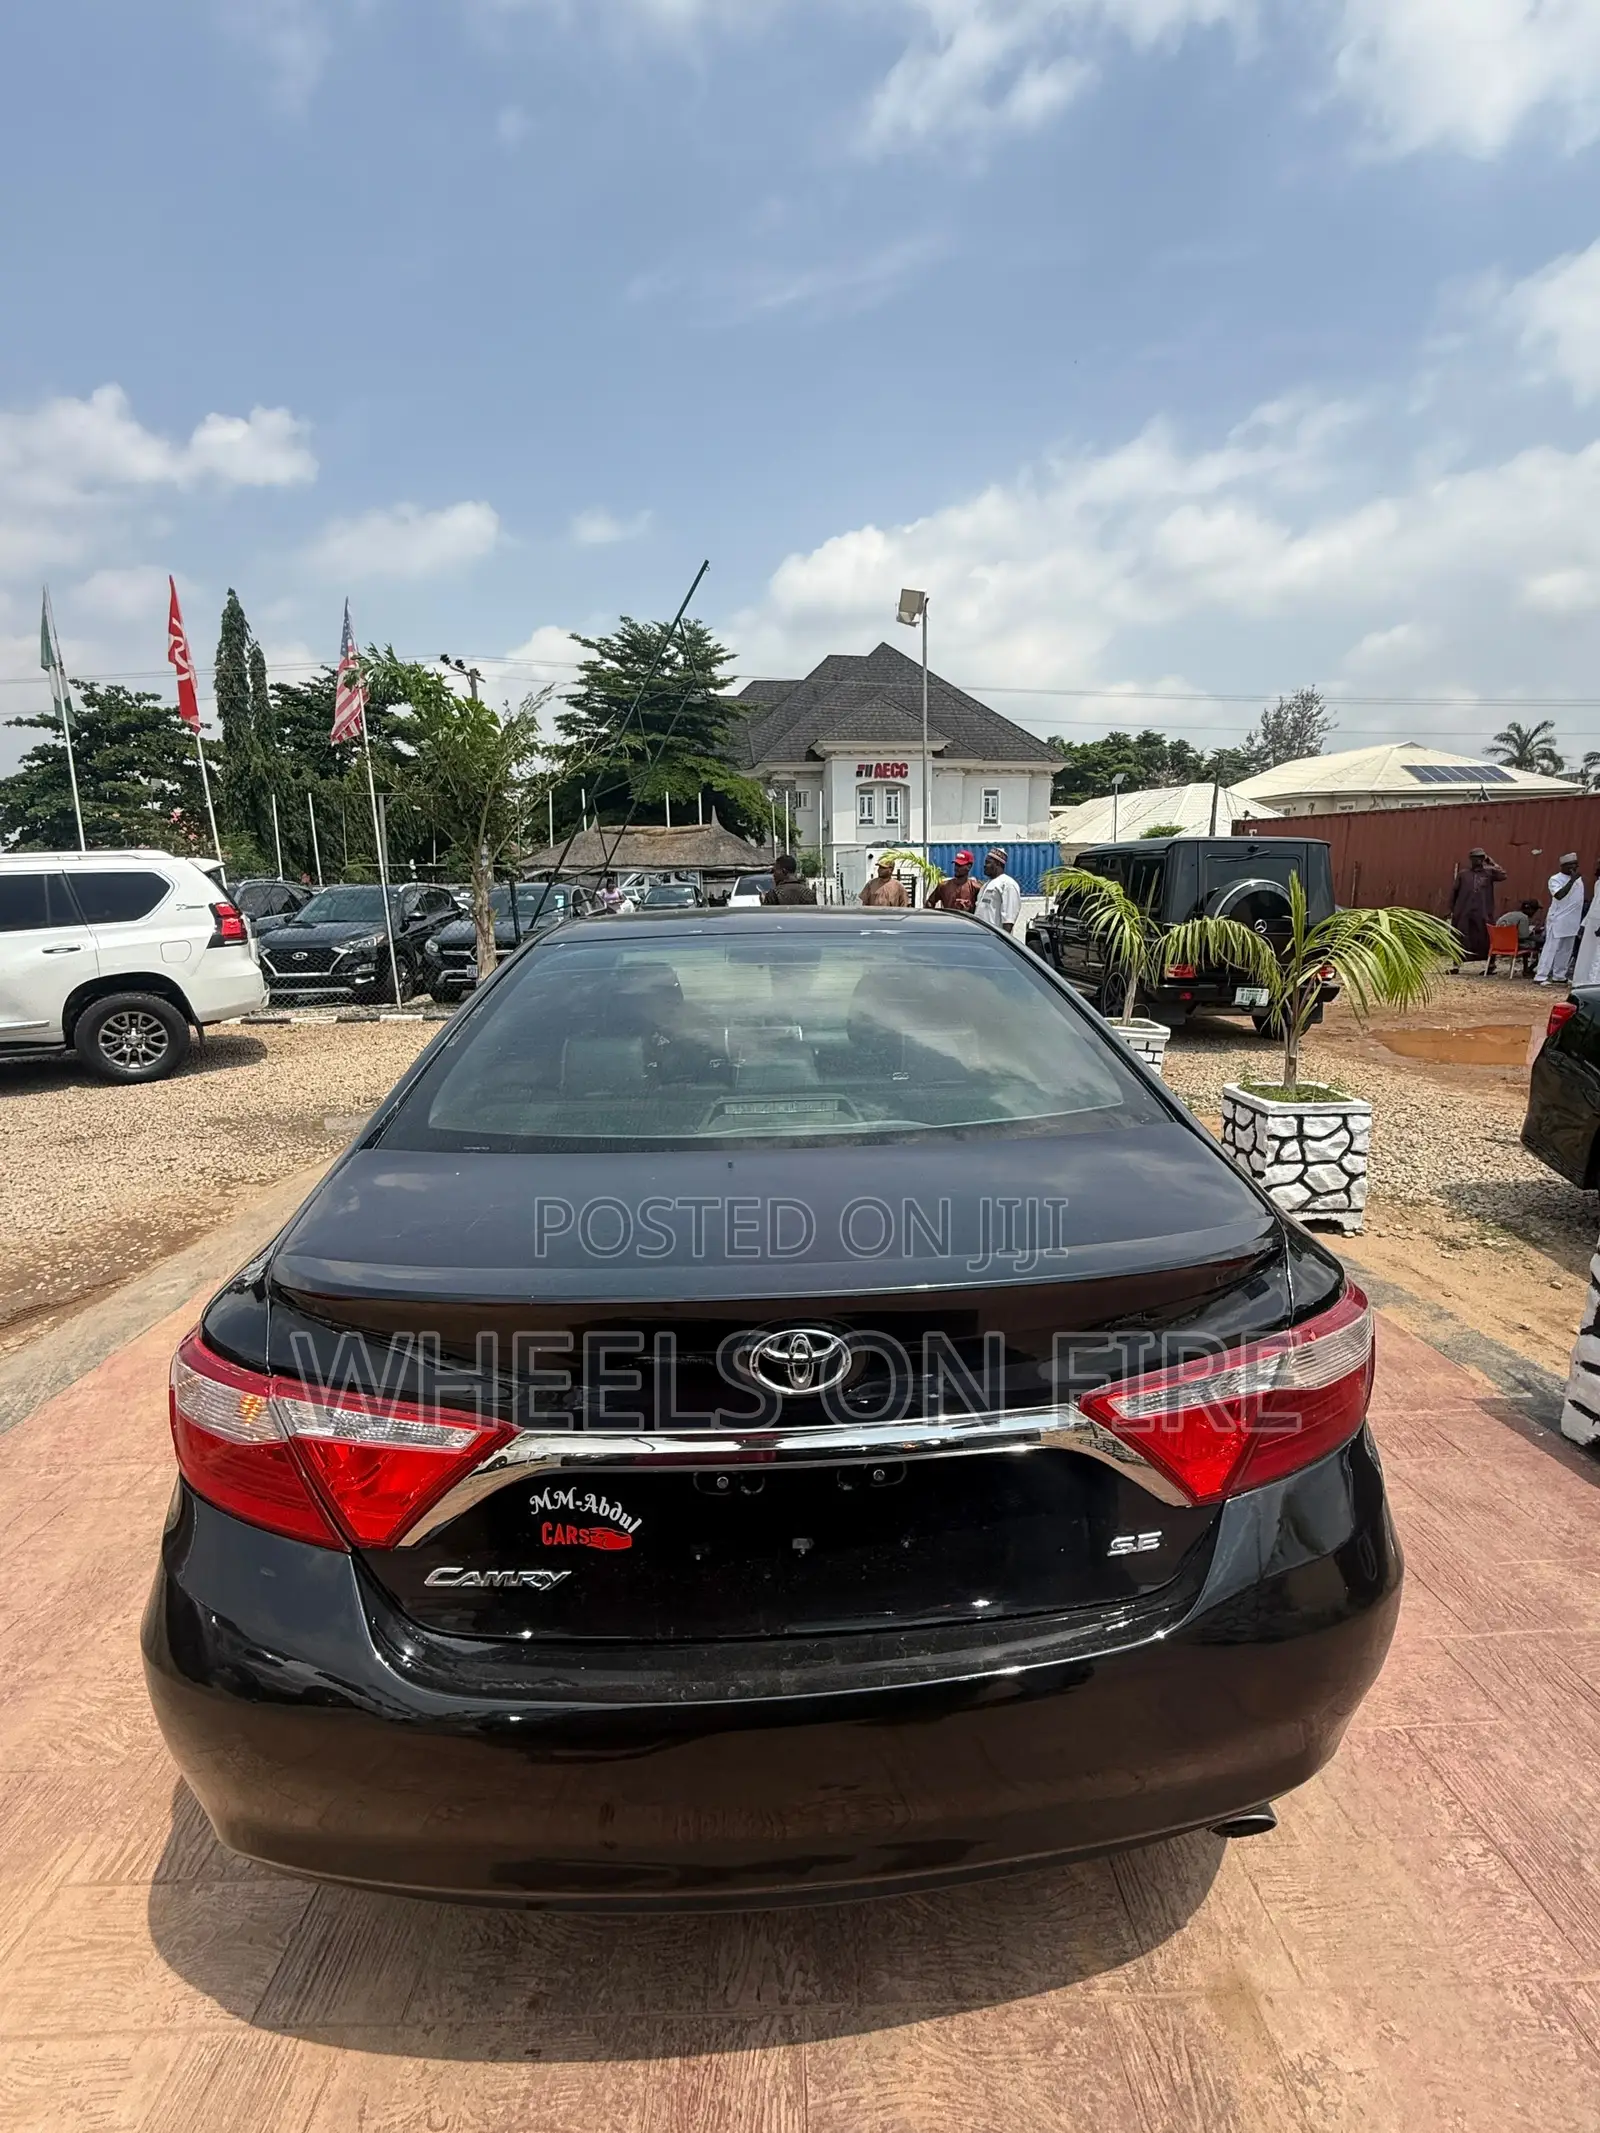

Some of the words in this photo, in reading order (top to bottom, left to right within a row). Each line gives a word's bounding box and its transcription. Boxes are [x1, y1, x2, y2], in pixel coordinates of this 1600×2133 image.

[874, 762, 909, 779] AECC
[529, 1486, 643, 1534] MM-Abdul
[541, 1521, 590, 1546] CARS
[1106, 1530, 1163, 1557] SE
[423, 1567, 573, 1591] CAMRY
